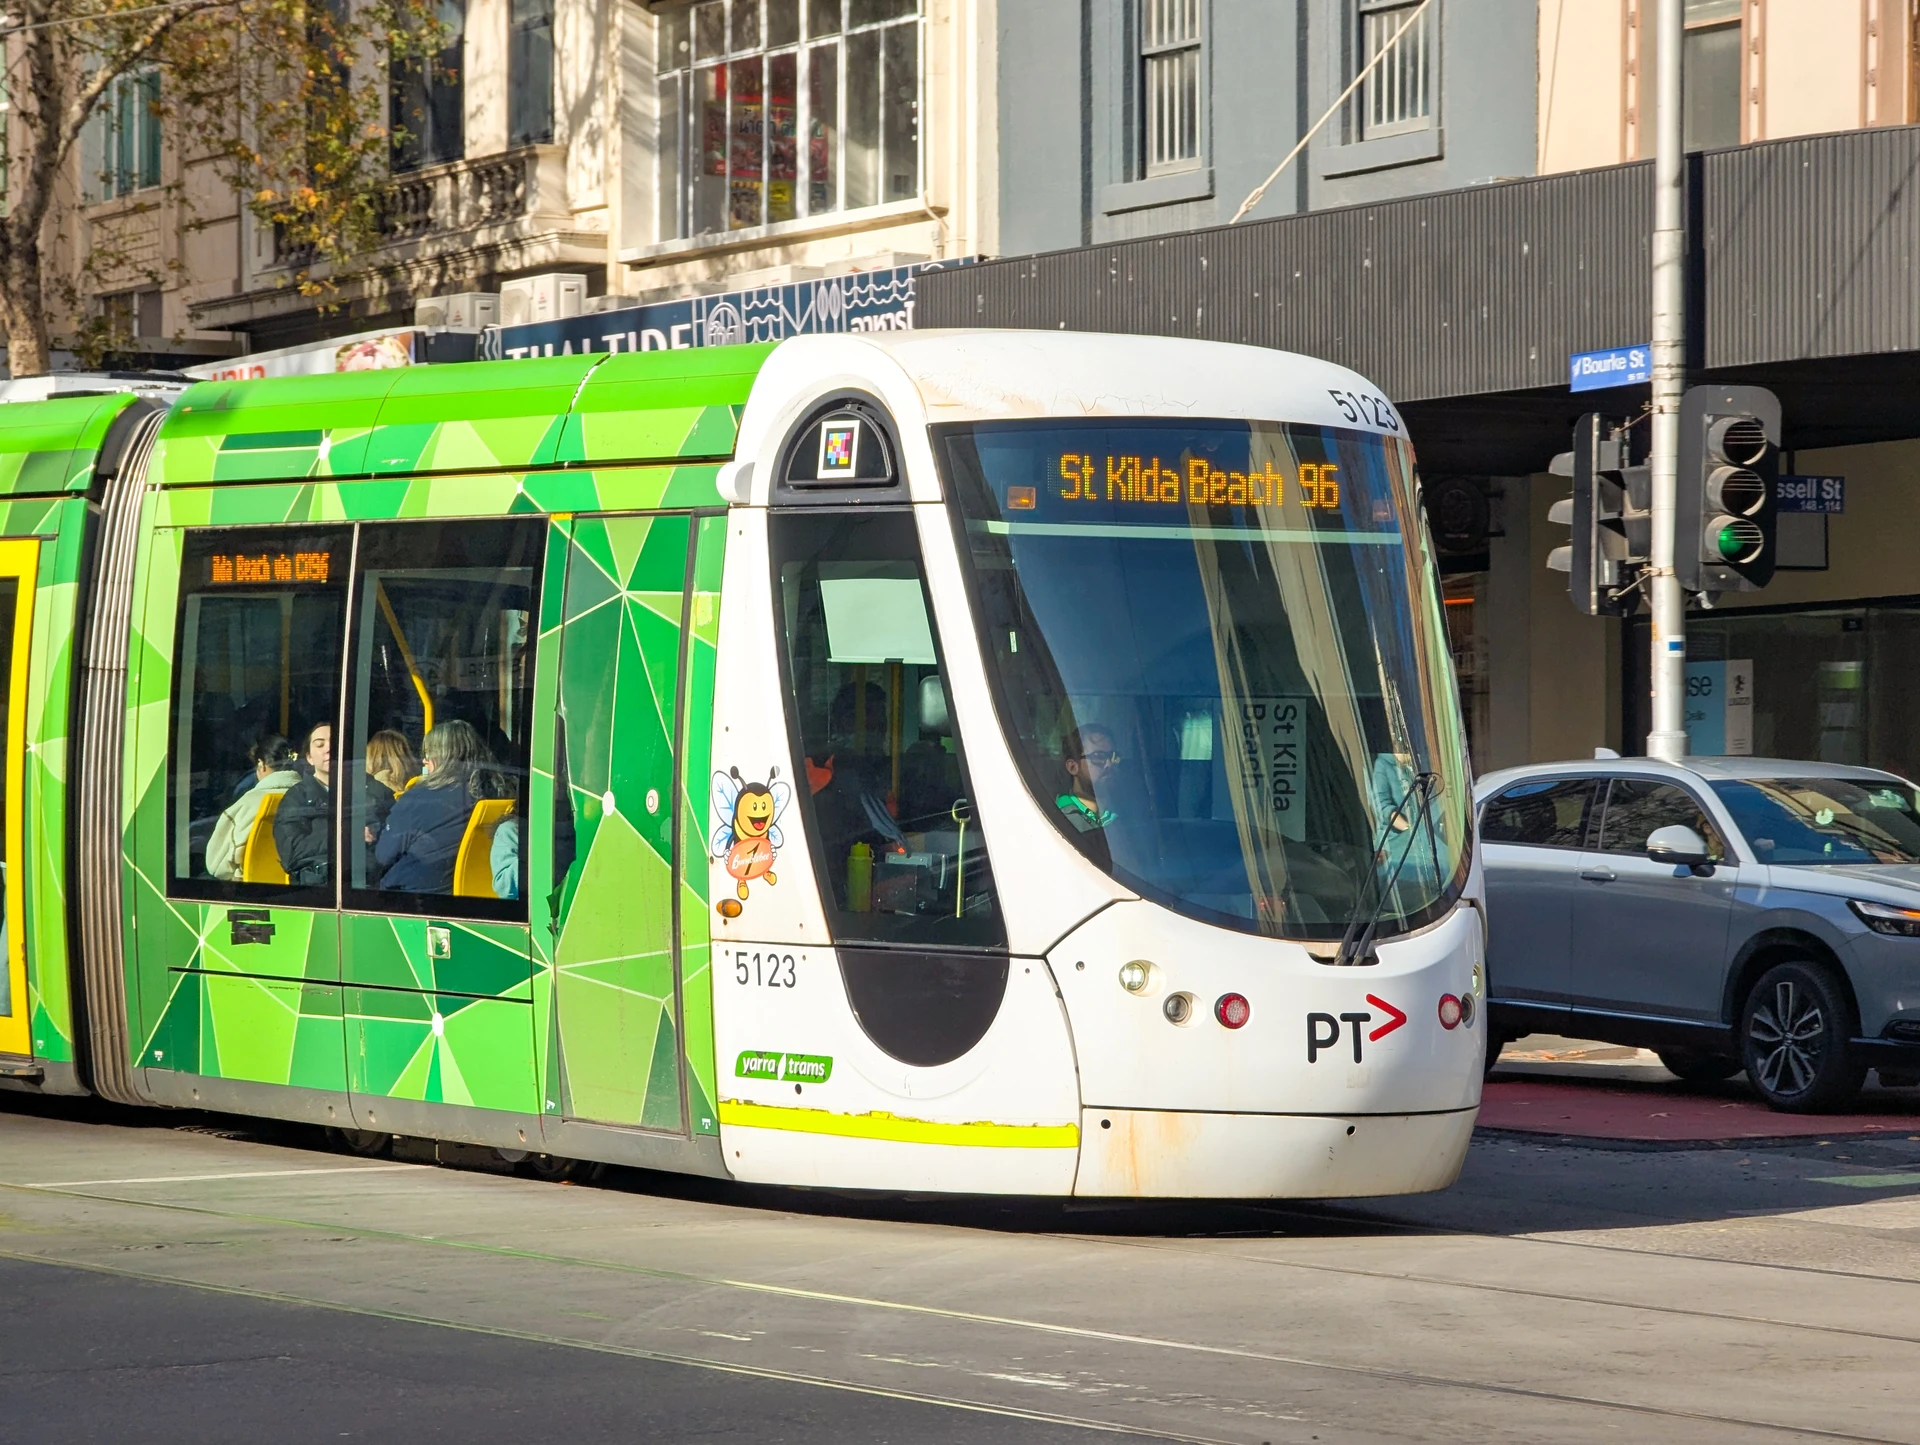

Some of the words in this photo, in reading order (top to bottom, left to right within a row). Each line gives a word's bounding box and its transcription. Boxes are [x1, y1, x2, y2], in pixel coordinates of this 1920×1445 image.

[1582, 353, 1627, 375] Bourke
[1629, 350, 1645, 368] St
[1327, 389, 1399, 431] 5123
[1060, 453, 1098, 500] St
[1106, 455, 1180, 503] Kilda
[1189, 459, 1283, 507] Beach
[1299, 463, 1339, 508] 96
[1821, 478, 1842, 500] St
[1273, 704, 1298, 735] St
[1273, 743, 1297, 812] Kilda
[735, 951, 797, 989] 5123
[742, 1056, 776, 1074] yarra
[788, 1058, 826, 1077] trams
